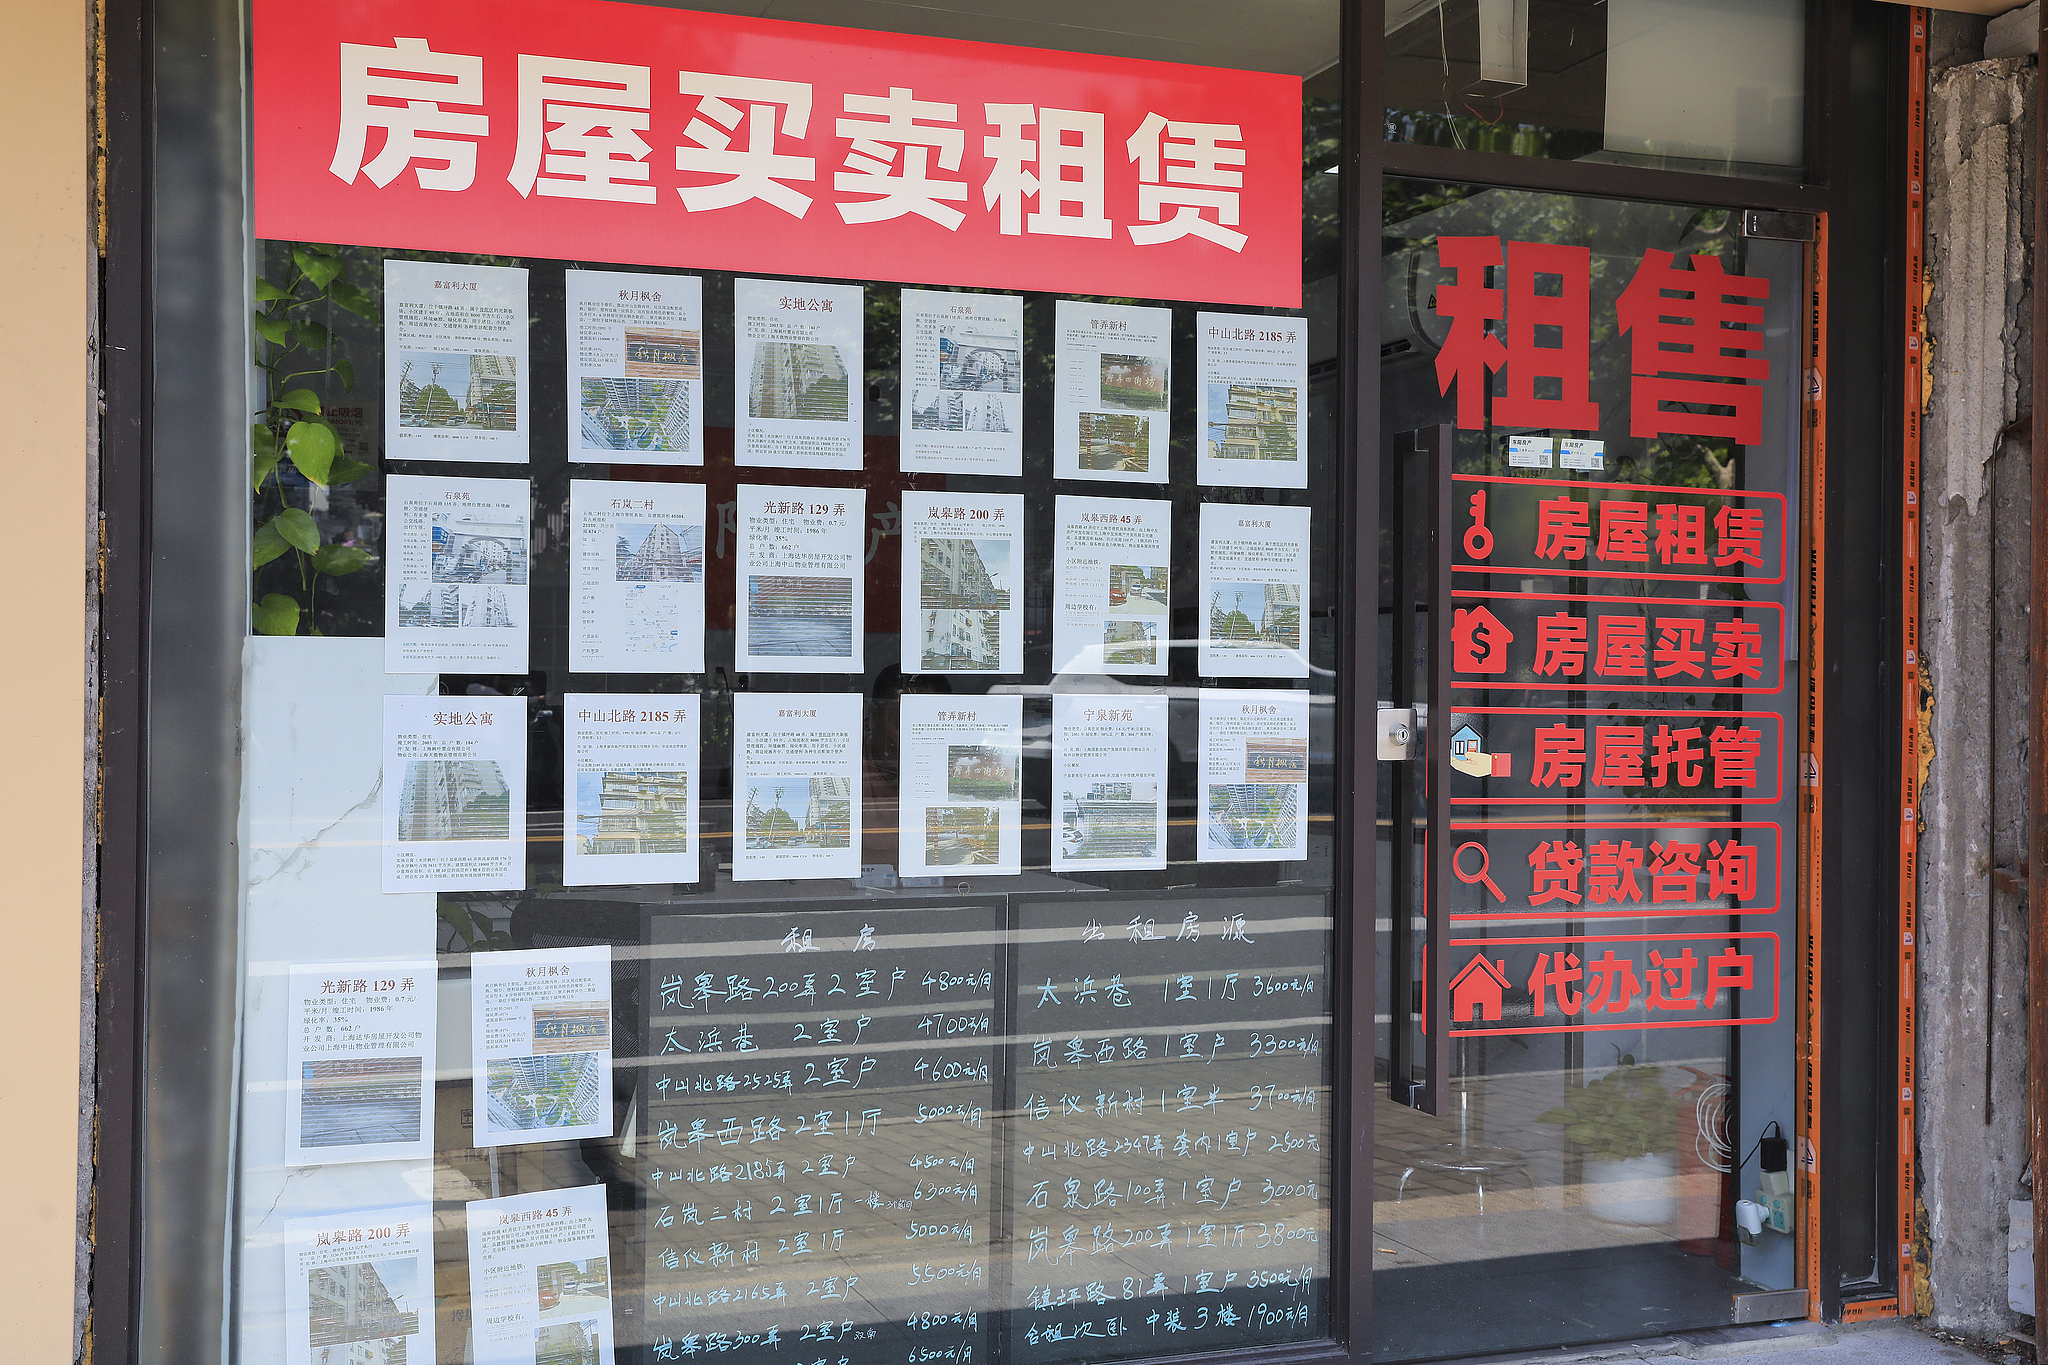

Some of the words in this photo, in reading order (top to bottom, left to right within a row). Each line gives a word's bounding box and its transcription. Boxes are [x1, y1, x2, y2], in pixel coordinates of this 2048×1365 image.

[328, 36, 1250, 256] 房屋买卖租赁
[434, 280, 478, 291] 嘉富利大厦
[619, 290, 662, 302] 秋月枫舍
[779, 296, 834, 312] 实地公寓
[950, 306, 972, 314] 石泉苑
[1090, 319, 1128, 332] 管弄新村
[1208, 326, 1256, 342] 中山北路
[1259, 331, 1283, 342] 2185
[1286, 331, 1297, 343] 弄
[1434, 236, 1769, 446] 租售
[444, 492, 470, 500] 石泉苑
[610, 499, 654, 510] 石岚二村
[764, 501, 804, 515] 光新路
[809, 504, 829, 515] 129
[833, 503, 846, 516] 弄
[928, 507, 966, 520] 岚皋路
[970, 510, 989, 519] 200
[993, 508, 1005, 521] 弄
[1081, 512, 1118, 523] 岚皋西路
[1121, 515, 1131, 524] 45
[1134, 514, 1142, 525] 弄
[1238, 519, 1272, 528] 嘉富利大厦
[1535, 496, 1764, 569] 房屋租赁
[1532, 612, 1764, 680] 房屋买卖
[433, 711, 494, 726] 实地公寓
[578, 709, 636, 723] 中山北路
[641, 711, 669, 722] 2185
[674, 709, 687, 723] 弄
[778, 709, 817, 717] 嘉富利大厦
[938, 711, 976, 721] 管弄新村
[1083, 709, 1133, 722] 宁泉新苑
[1241, 704, 1277, 715] 秋月枫舍
[1529, 723, 1762, 789] 房屋托管
[1527, 839, 1758, 906] 贷款咨询
[1082, 911, 1254, 944] 出租房源
[525, 966, 570, 977] 秋月枫舍
[827, 967, 906, 1001] 2室户
[921, 968, 992, 994] 4800元/月
[1527, 947, 1755, 1017] 代办过户
[320, 979, 368, 995] 光新路
[373, 980, 396, 992] 129
[400, 977, 415, 992] 弄
[1253, 974, 1315, 997] 3600元/月
[793, 1014, 872, 1045] 2室户
[1032, 1036, 1149, 1070] 岚皋西路
[1165, 1033, 1227, 1065] 1室户
[1249, 1033, 1319, 1059] 3300元/月
[804, 1056, 877, 1088] 2室户
[913, 1056, 989, 1082] 4600元/月
[1248, 1084, 1318, 1113] 3700元/月
[658, 1117, 787, 1153] 岚皋西路
[915, 1101, 982, 1129] 5000元/月
[801, 1154, 856, 1178] 2室户
[909, 1151, 975, 1175] 4500元/月
[654, 1200, 752, 1228] 石岚三村
[770, 1193, 842, 1216] 2室1厅
[913, 1180, 978, 1205] 6300元/月
[1182, 1175, 1242, 1210] 1室户
[1260, 1179, 1318, 1204] 3000元
[498, 1210, 543, 1226] 岚皋西路
[546, 1208, 559, 1218] 45
[562, 1206, 572, 1217] 弄
[316, 1229, 363, 1248] 岚皋路
[368, 1227, 391, 1240] 200
[396, 1223, 411, 1238] 弄
[777, 1229, 845, 1256] 2室1厅
[905, 1220, 974, 1243] 5000元/月
[1255, 1223, 1318, 1249] 3800元
[807, 1275, 859, 1301] 2室户
[908, 1259, 983, 1286] 5500元/月
[1183, 1269, 1237, 1294] 1室户
[800, 1318, 855, 1342] 2室户
[907, 1307, 978, 1332] 4800元/月
[1248, 1302, 1309, 1329] 1900元/月
[908, 1340, 972, 1365] 6500元/月
